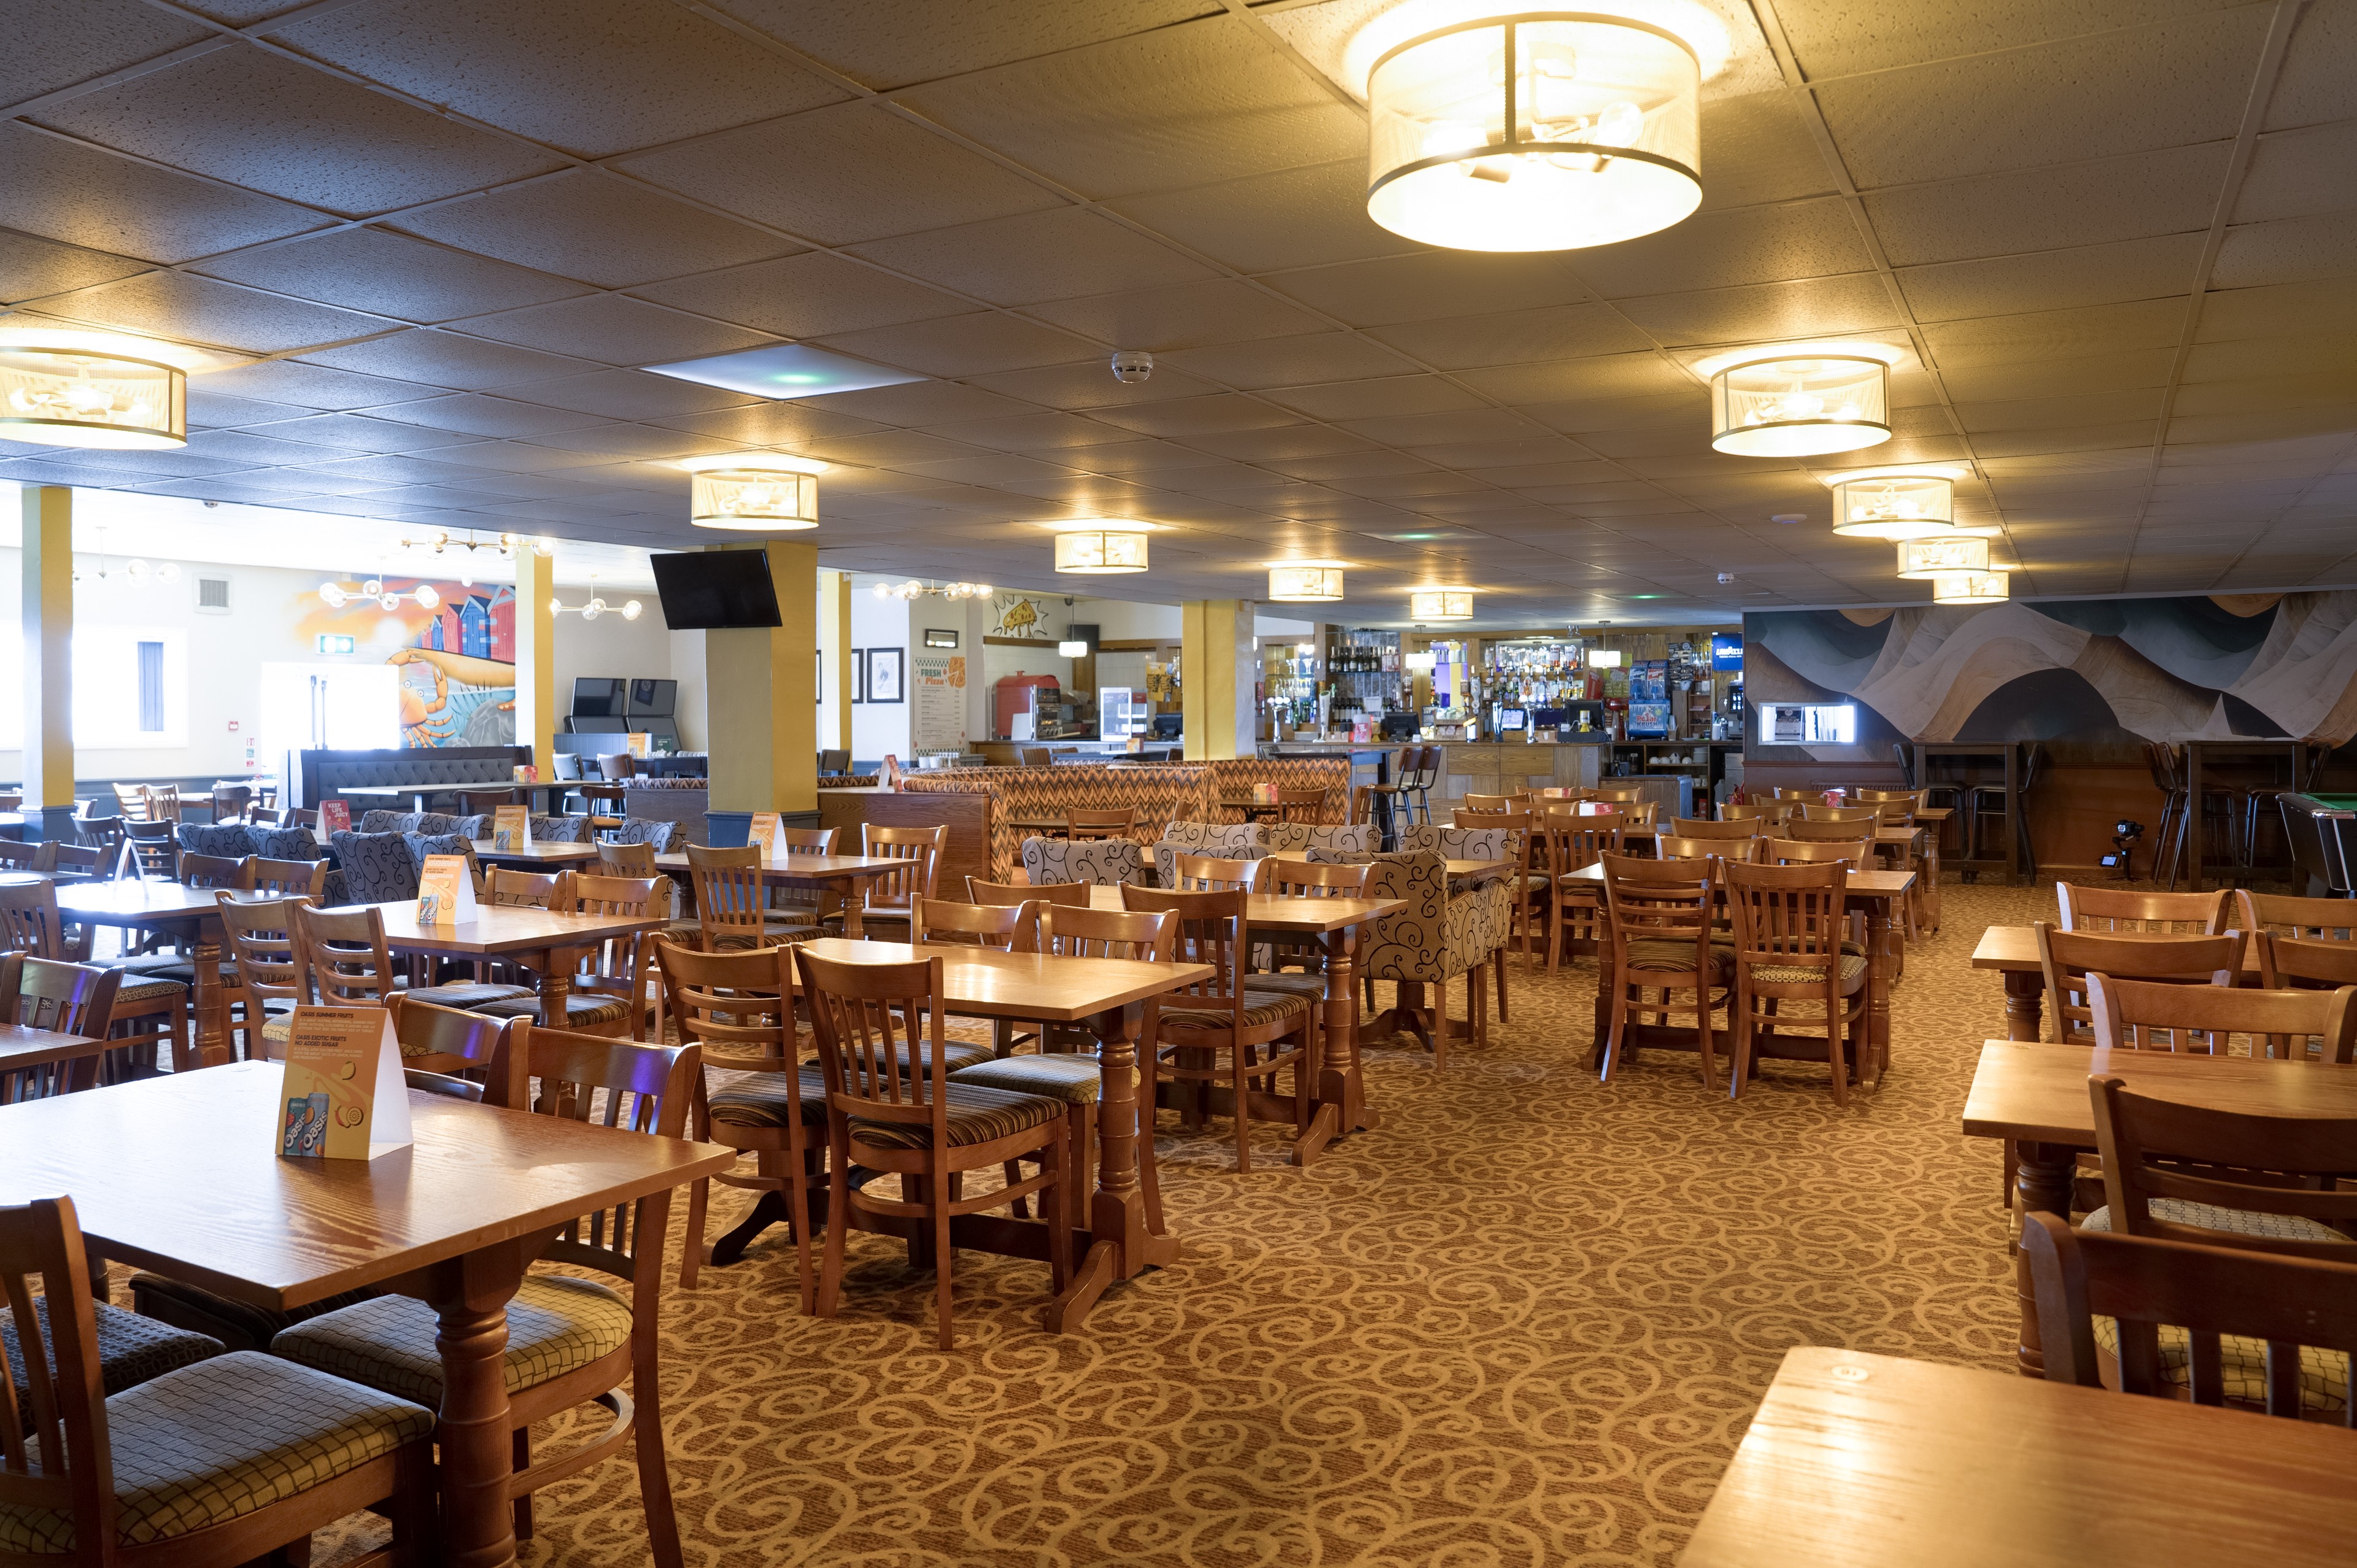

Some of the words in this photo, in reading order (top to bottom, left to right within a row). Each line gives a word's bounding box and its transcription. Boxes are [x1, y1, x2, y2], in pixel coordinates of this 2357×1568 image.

[921, 668, 941, 677] FRESH
[926, 676, 944, 685] Pizza
[1637, 713, 1657, 722] Polar
[304, 1111, 327, 1148] Oasis
